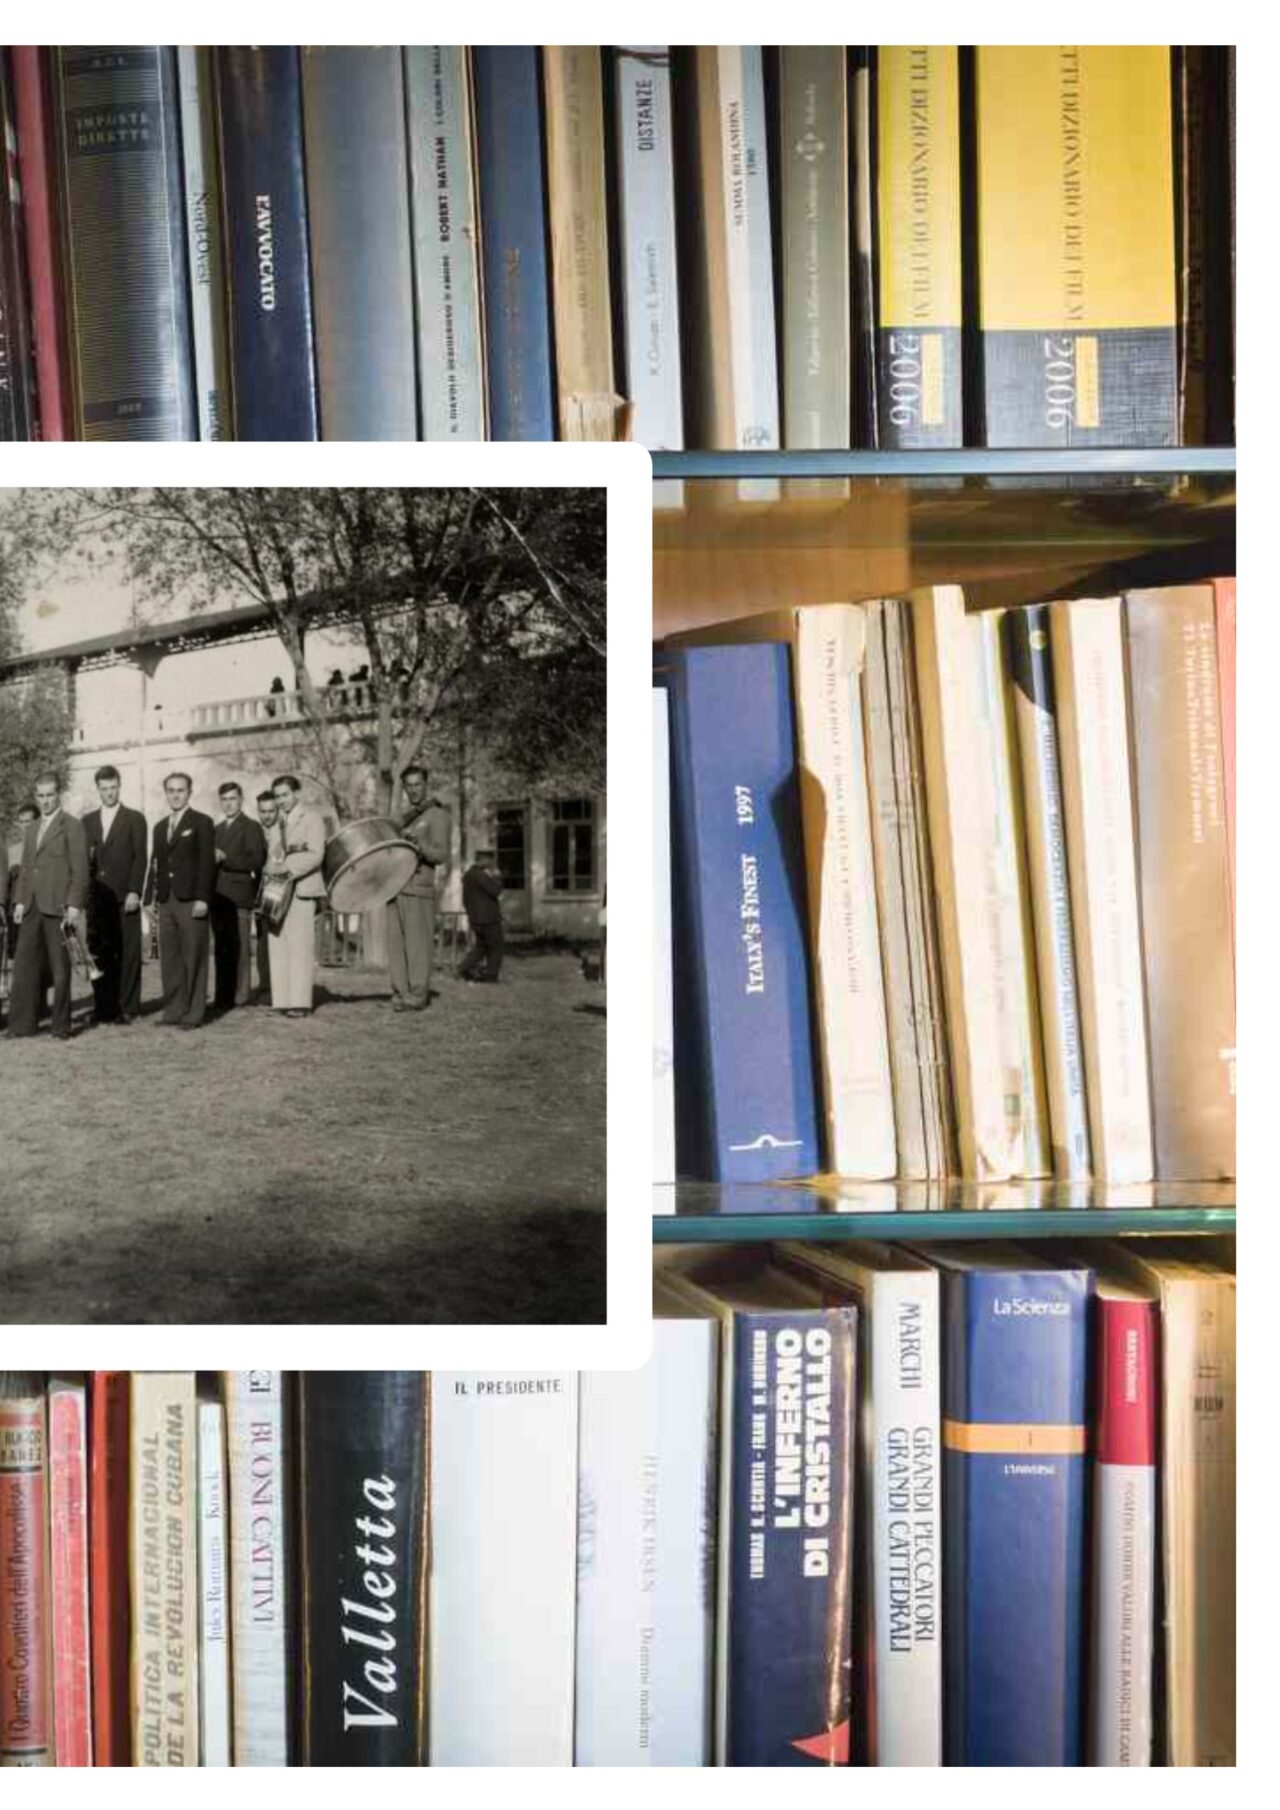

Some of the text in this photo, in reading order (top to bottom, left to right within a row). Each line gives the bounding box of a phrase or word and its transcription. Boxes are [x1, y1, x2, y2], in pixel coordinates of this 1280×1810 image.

[637, 78, 654, 151] DISTANZE
[909, 90, 930, 216] DIZIONARIO
[1060, 93, 1081, 217] DIZIONARIO
[436, 137, 452, 242] ROBERT NATHAN
[255, 195, 276, 311] L'AVVOCATO
[890, 334, 918, 426] 2006
[1046, 339, 1074, 428] 2006
[735, 785, 753, 826] 1997
[740, 854, 764, 994] ITALY'S FINEST
[455, 1379, 562, 1395] IL PRESIDENTE
[899, 1302, 922, 1389] MARCHI
[774, 1329, 803, 1528] L'INFERNO
[804, 1328, 832, 1578] DI CRISTALLO
[251, 1420, 275, 1622] BUONI CATTIVI
[750, 1534, 765, 1579] THOMAS
[887, 1427, 911, 1653] GRANDI CATTEDRALI
[913, 1426, 935, 1643] GRANDI PECCATORI
[141, 1431, 161, 1766] POLITICA INTERNACIONAL
[164, 1403, 185, 1766] DE LA REVOLUCION CUBANA
[342, 1473, 399, 1733] Valletta
